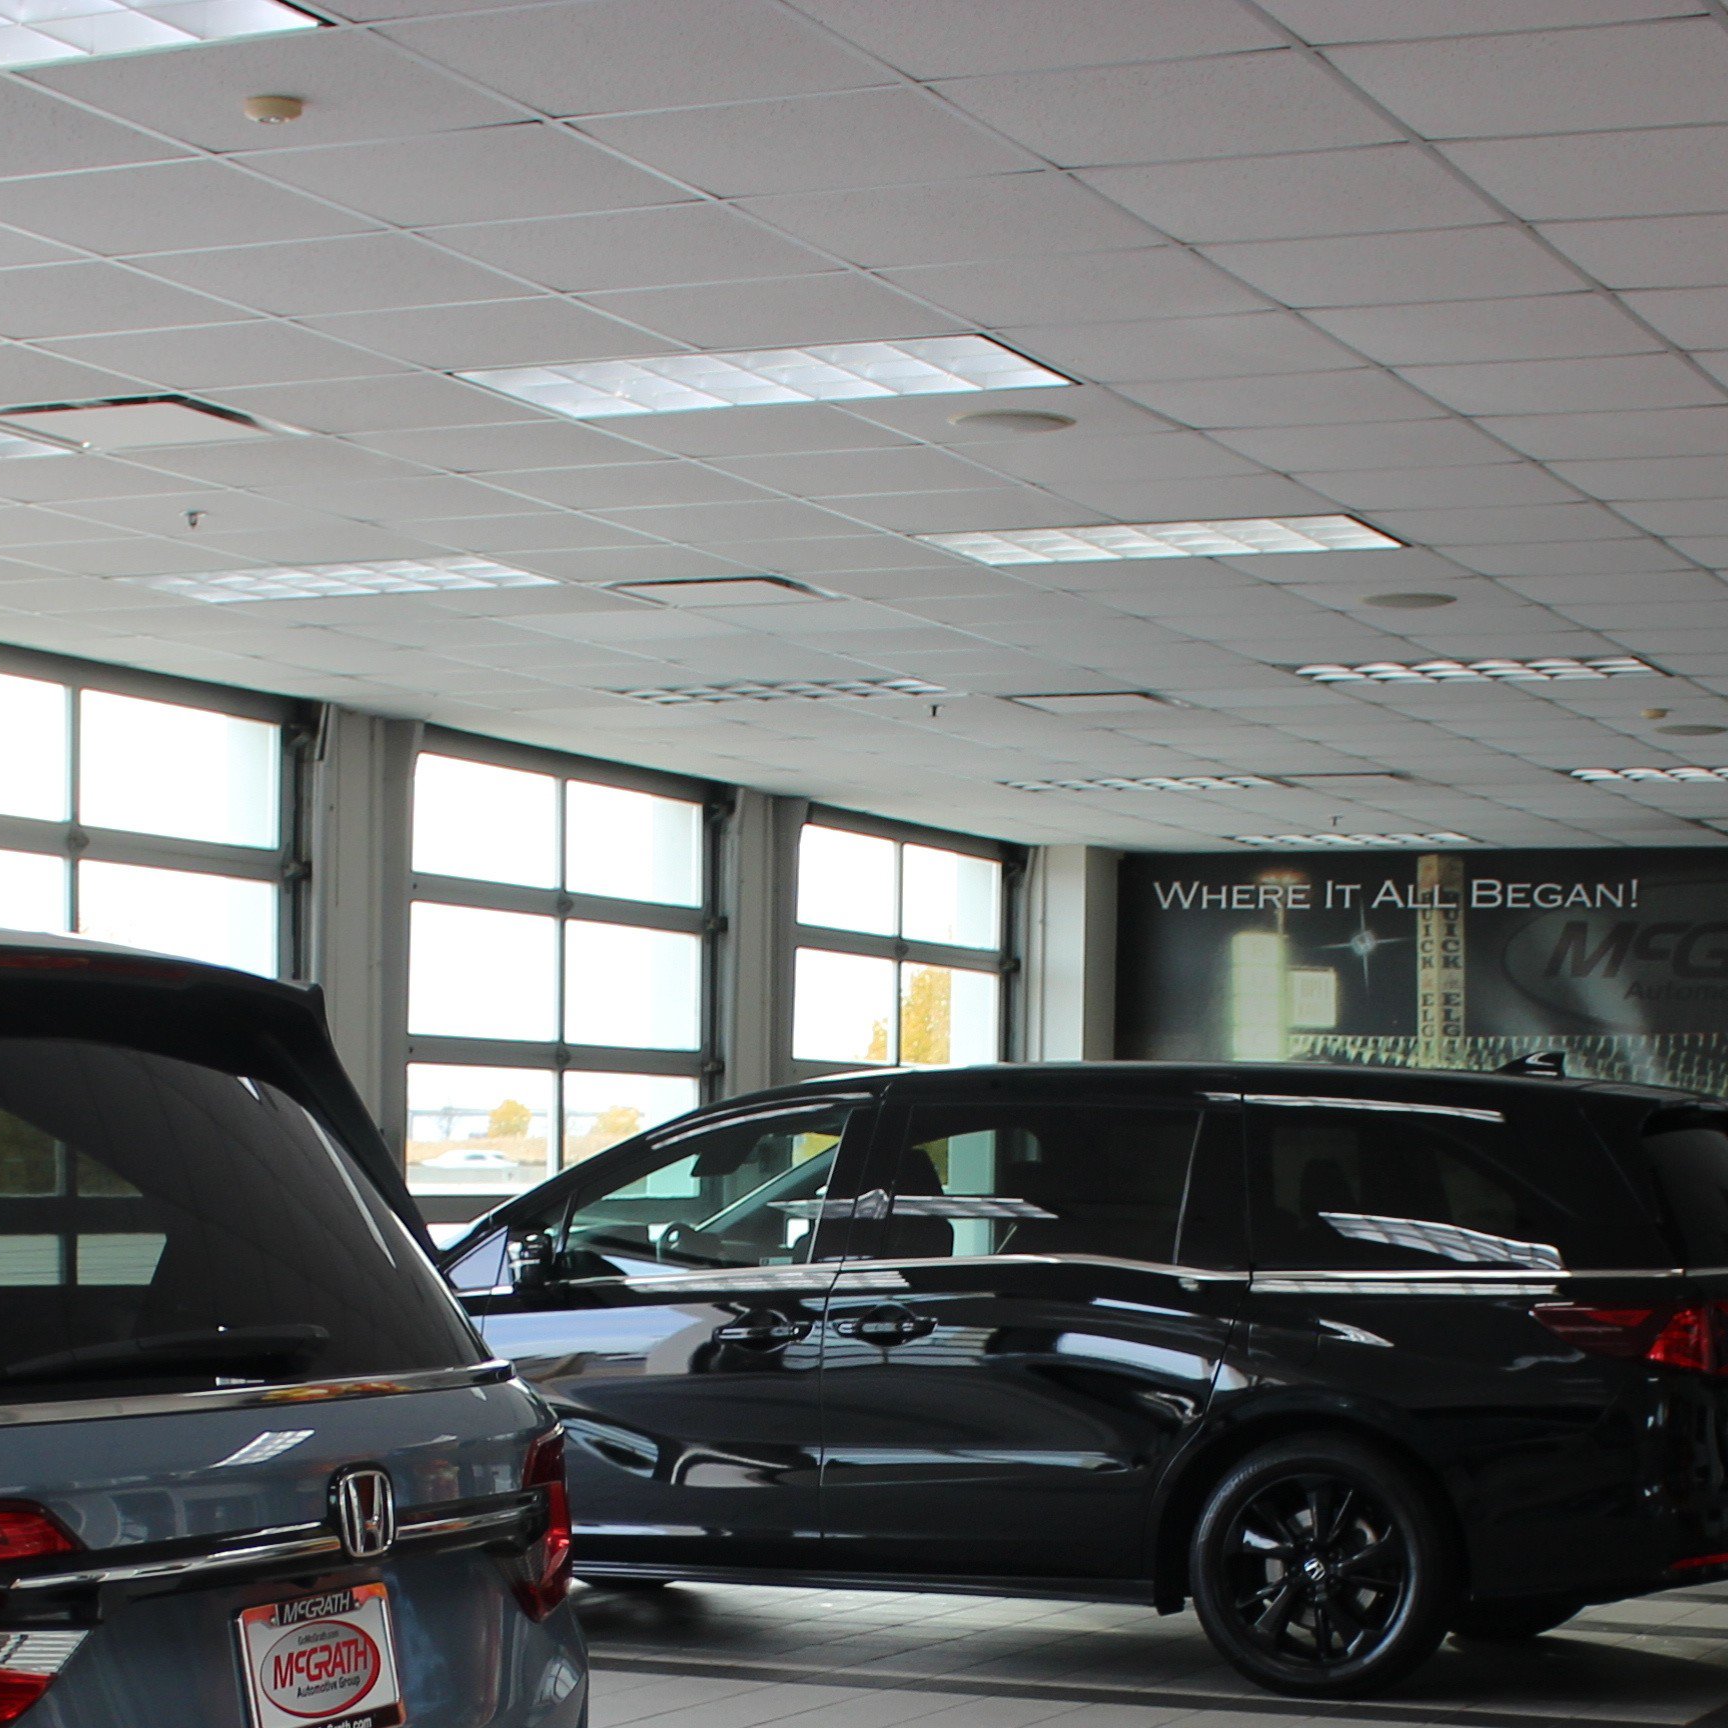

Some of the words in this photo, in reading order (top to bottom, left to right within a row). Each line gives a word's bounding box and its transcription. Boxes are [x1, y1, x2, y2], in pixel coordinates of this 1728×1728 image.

[283, 1591, 351, 1624] McGRATH
[273, 1637, 369, 1690] McGRATH
[296, 1677, 338, 1699] Automotive
[338, 1674, 362, 1690] Group
